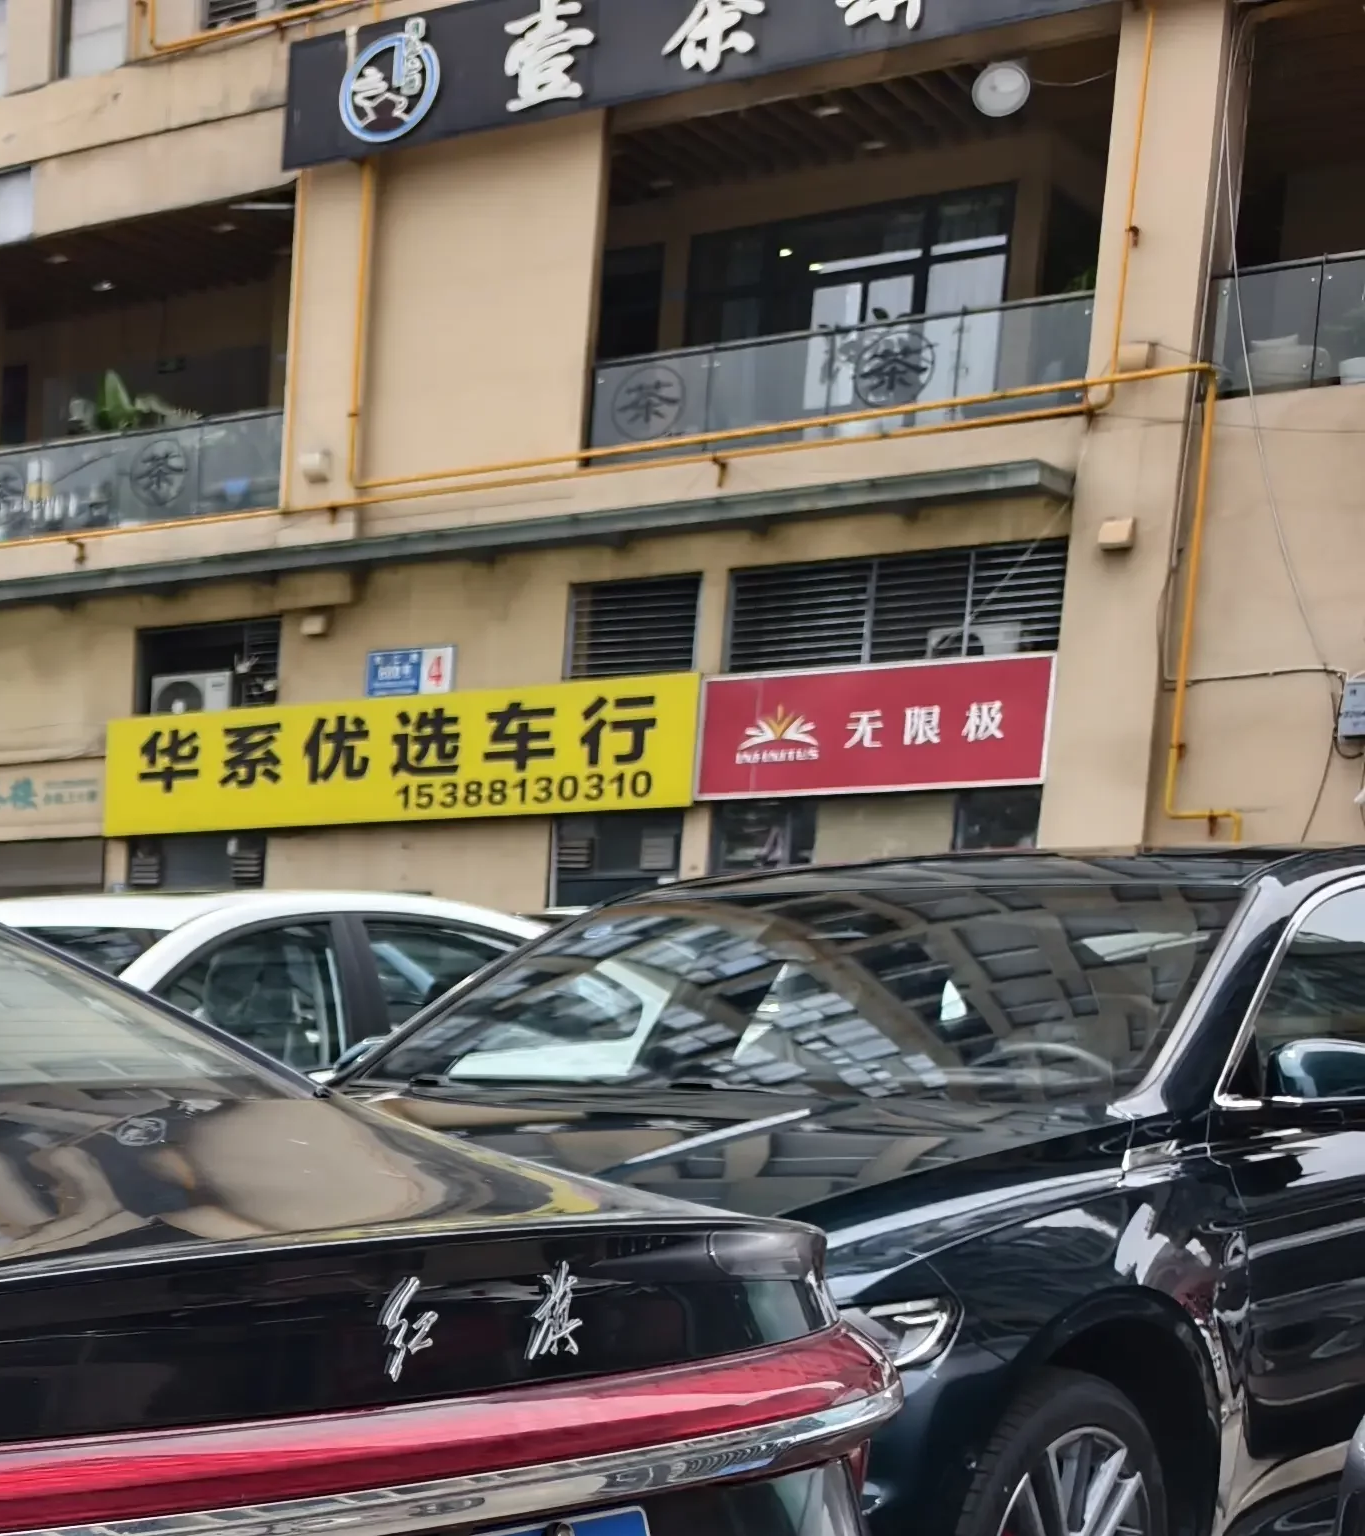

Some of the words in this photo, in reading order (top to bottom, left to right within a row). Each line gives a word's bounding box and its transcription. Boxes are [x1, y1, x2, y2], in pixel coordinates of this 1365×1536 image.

[428, 655, 443, 687] 4
[138, 694, 658, 794] 华系优选车行
[844, 700, 1004, 749] 无限极
[395, 769, 653, 811] 15388130310
[378, 1260, 581, 1382] 红旗
